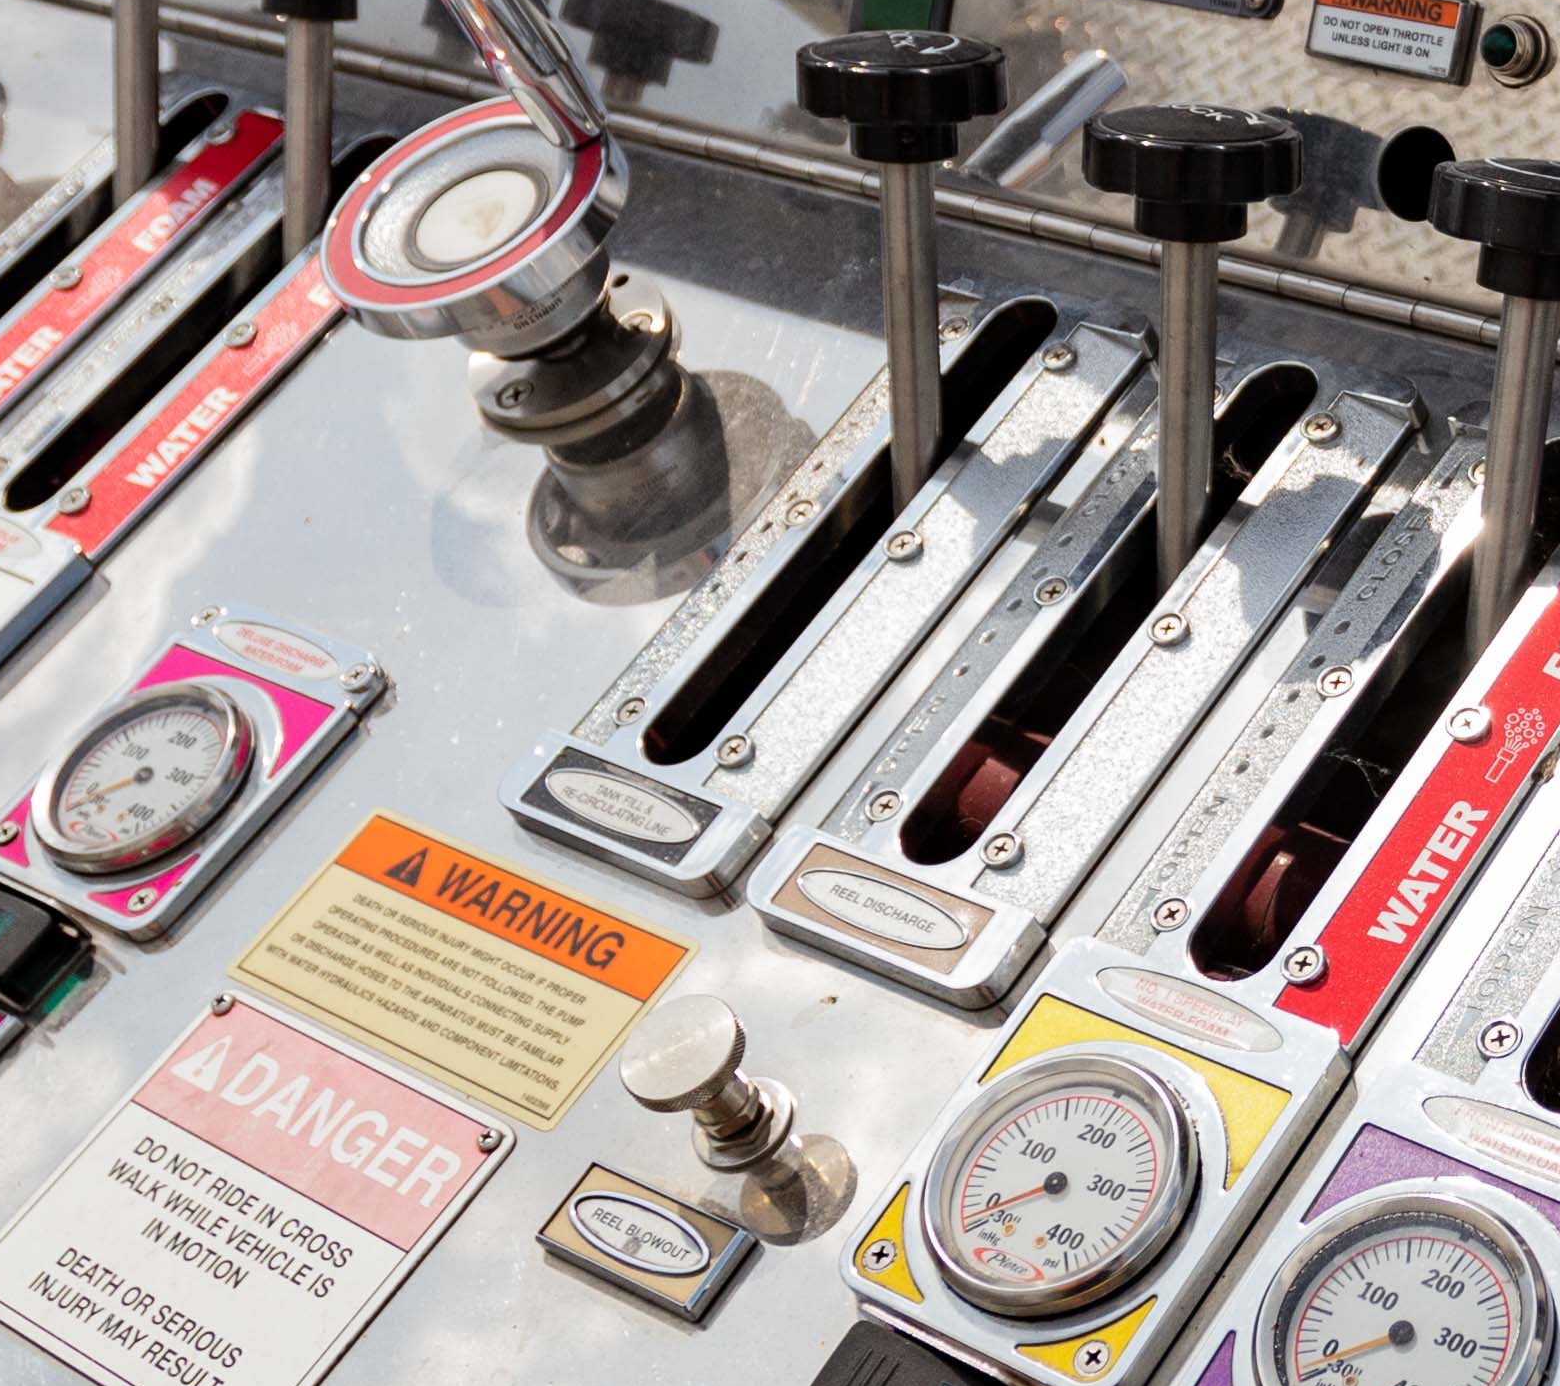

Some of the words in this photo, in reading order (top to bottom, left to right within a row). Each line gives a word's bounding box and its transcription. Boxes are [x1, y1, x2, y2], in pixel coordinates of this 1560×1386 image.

[1324, 16, 1337, 26] DO
[1340, 19, 1361, 30] NOT
[1363, 23, 1390, 36] OPEN
[1392, 28, 1444, 46] THROTTLE
[1332, 32, 1370, 46] UNLESS
[1372, 39, 1401, 52] LIGHT
[1403, 45, 1412, 55] IS
[1414, 47, 1430, 58] ON
[134, 178, 216, 253] FOAM
[1367, 800, 1488, 947] WATER
[352, 893, 381, 911] DEATH
[382, 905, 398, 920] OR
[399, 913, 439, 938] SERIOUS
[439, 930, 470, 953] INJURY
[470, 945, 499, 966] MIGHT
[500, 960, 536, 983] OCCUR
[546, 980, 586, 1006] PROPER
[436, 864, 625, 969] WARNING
[221, 1052, 462, 1209] DANGER
[1018, 1139, 1056, 1164] 100
[1077, 1124, 1117, 1149] 200
[133, 1137, 167, 1163] DO
[164, 1153, 211, 1187] NOT
[209, 1177, 256, 1217] RIDE
[255, 1201, 279, 1228] IN
[280, 1217, 354, 1269] CROSS
[1086, 1174, 1126, 1200] 300
[108, 1158, 163, 1202] WALK
[164, 1190, 226, 1236] WHILE
[225, 1229, 312, 1284] VEHICLE
[308, 1272, 335, 1298] IS
[142, 1218, 168, 1243] IN
[165, 1232, 251, 1290] MOTION
[591, 1206, 624, 1231] REEL
[626, 1223, 690, 1261] BLOWOUT
[1045, 1223, 1085, 1249] 400
[29, 1272, 102, 1324] INJURY
[98, 1313, 148, 1349] MAY
[56, 1248, 124, 1297] DEATH
[121, 1286, 153, 1311] OR
[151, 1305, 244, 1369] SERIOUS
